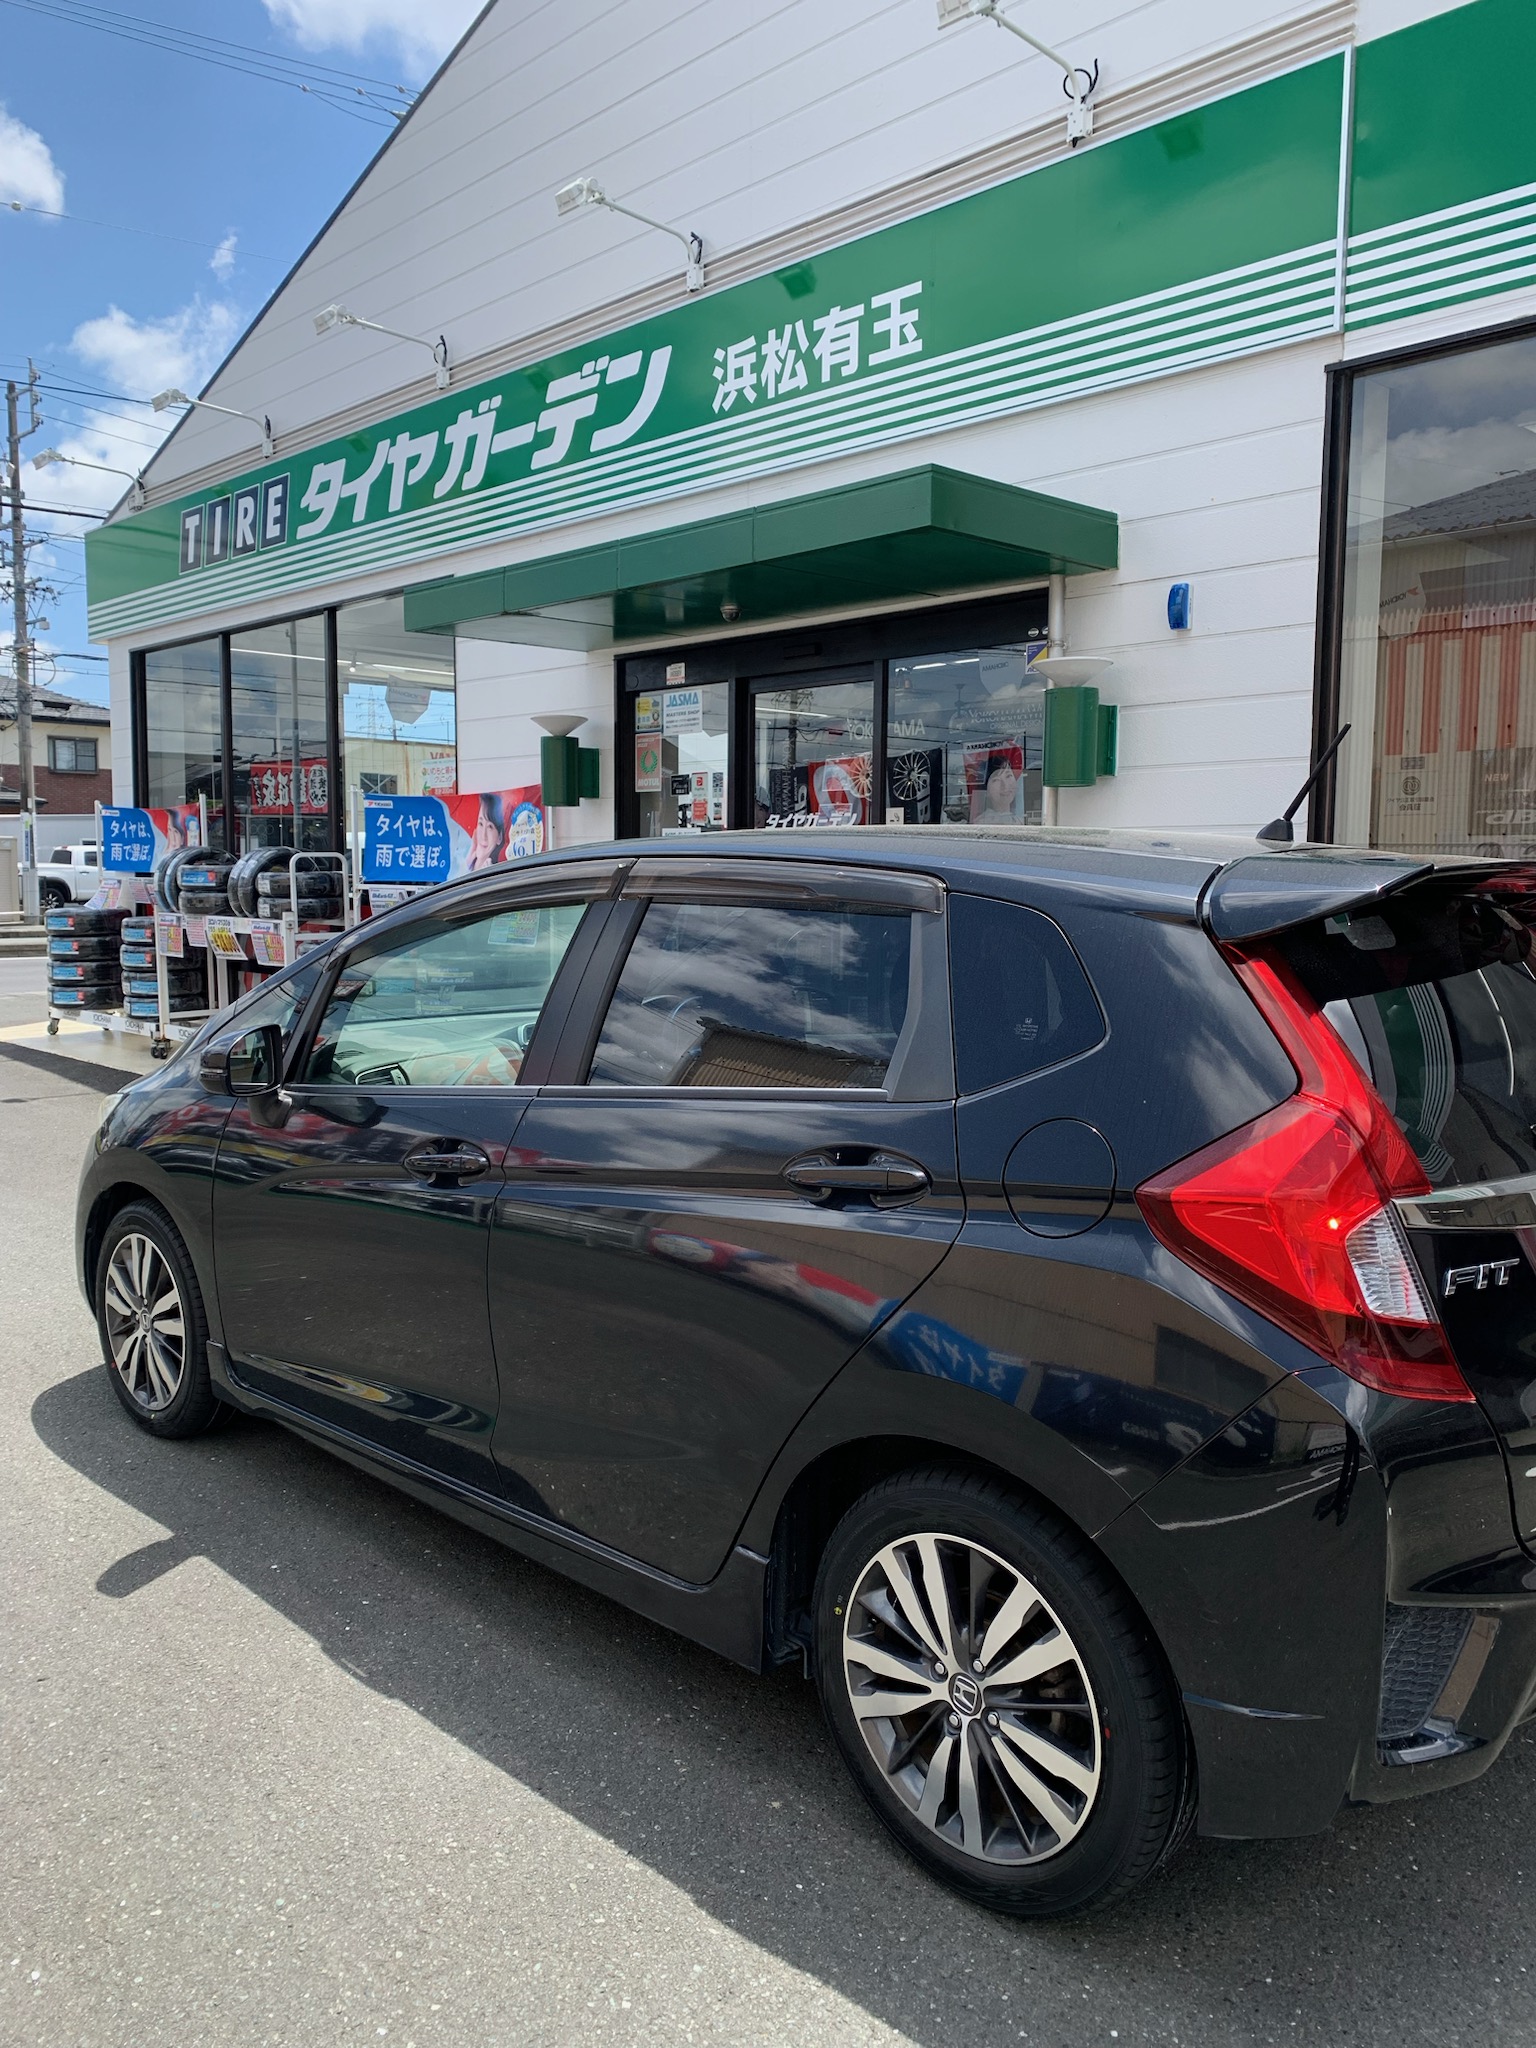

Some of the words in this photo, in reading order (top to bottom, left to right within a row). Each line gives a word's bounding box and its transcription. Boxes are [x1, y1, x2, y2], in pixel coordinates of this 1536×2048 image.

[184, 483, 284, 564] TIRE
[296, 345, 673, 540] タイヤガーデン
[711, 280, 923, 414] 浜松有玉
[666, 691, 699, 708] JASMA
[846, 718, 926, 741] YOKAMA
[637, 778, 660, 787] MOTUL
[1484, 773, 1510, 782] NEW
[110, 820, 151, 838] タイヤは、
[376, 814, 443, 838] タイヤは、
[766, 812, 858, 828] タイヤガーデン
[110, 843, 152, 862] 雨で選ぼ。
[375, 844, 446, 868] 雨で選ぼ。
[1444, 1257, 1521, 1298] FIT
